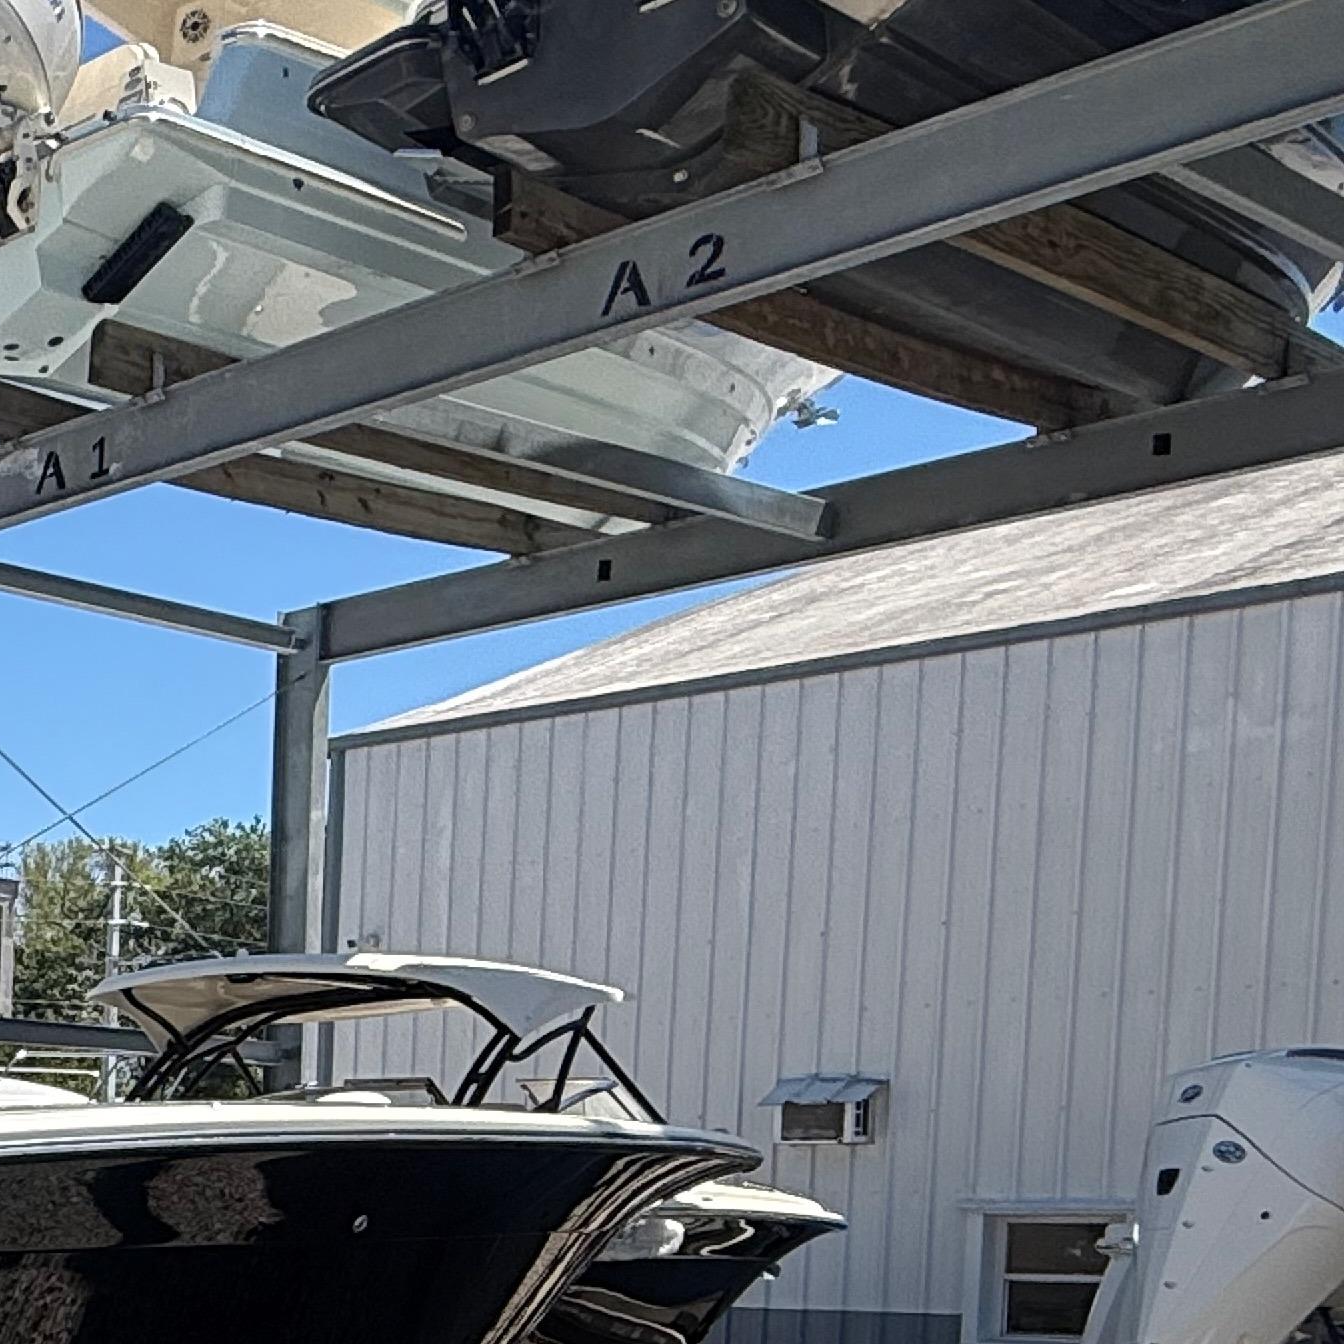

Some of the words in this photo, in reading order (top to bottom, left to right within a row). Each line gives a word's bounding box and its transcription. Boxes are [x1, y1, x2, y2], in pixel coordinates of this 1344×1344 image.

[601, 259, 652, 317] A
[686, 233, 726, 288] 2
[35, 450, 66, 495] A
[90, 436, 110, 479] 1
